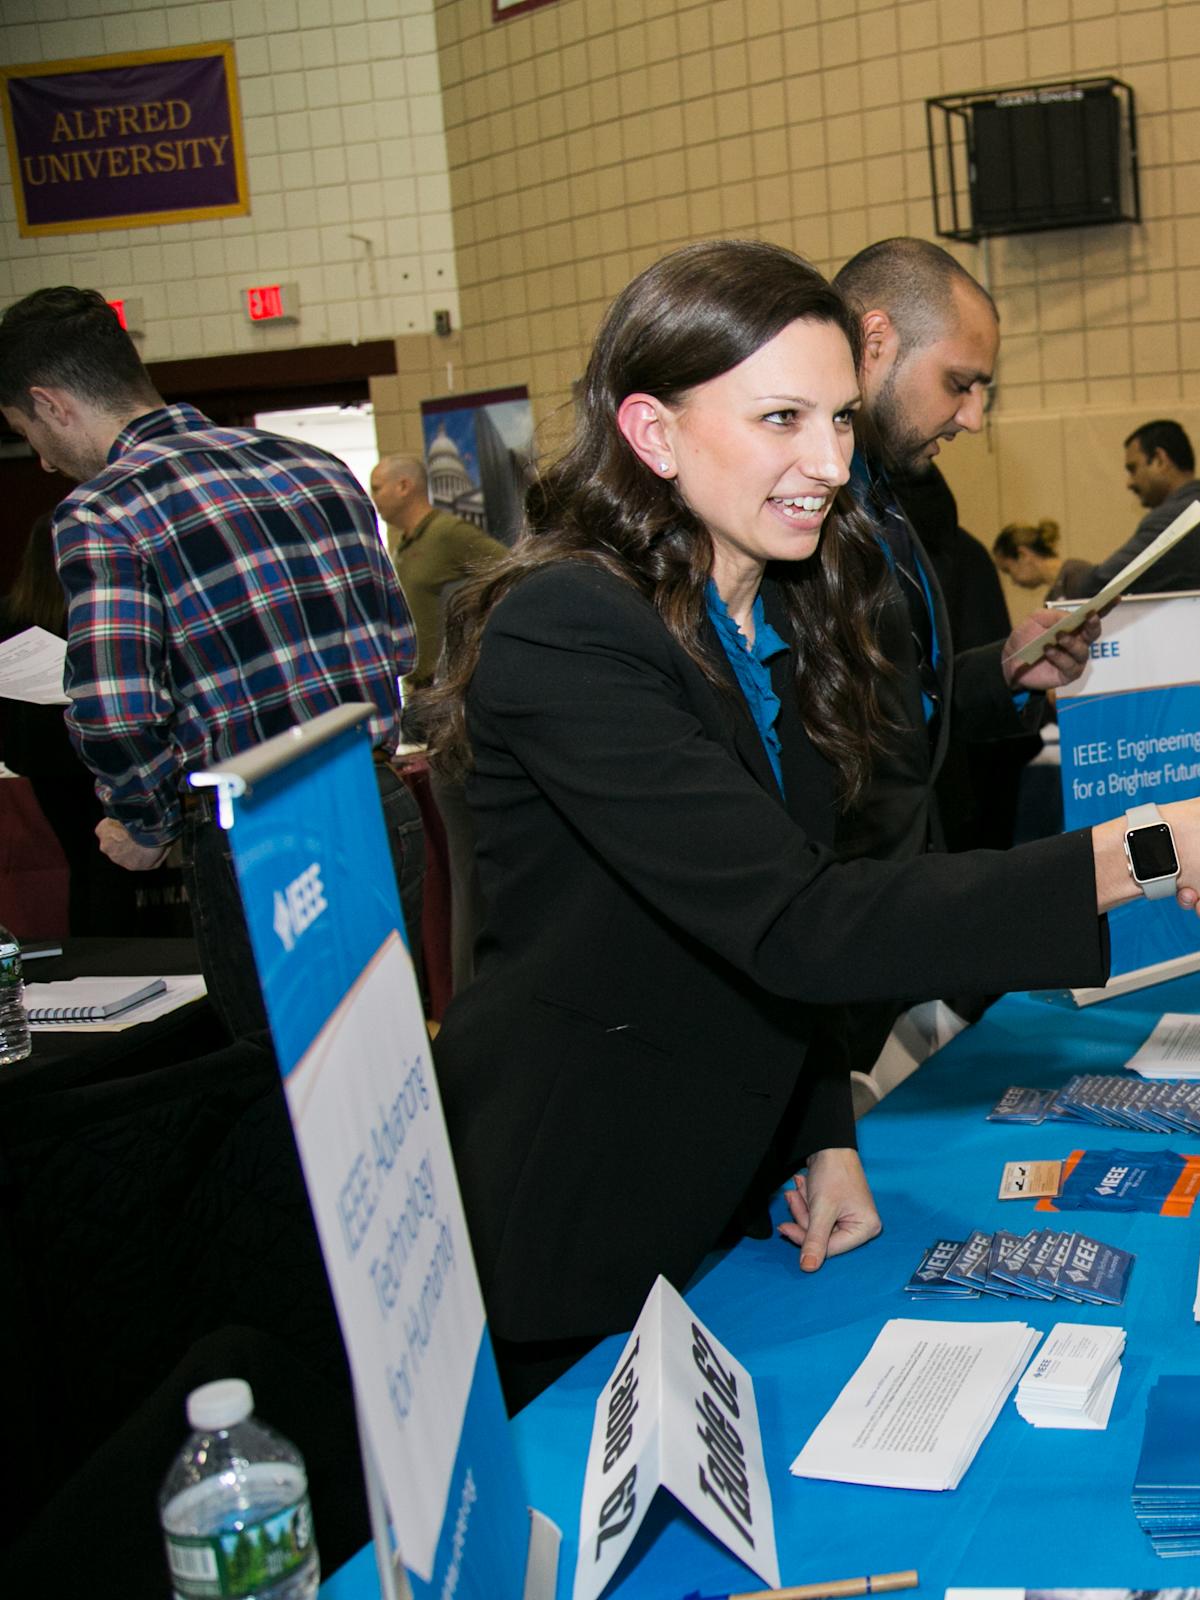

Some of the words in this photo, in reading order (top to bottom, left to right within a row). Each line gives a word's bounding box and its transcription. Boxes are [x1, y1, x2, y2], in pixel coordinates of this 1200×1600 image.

[51, 99, 193, 143] ALFRED
[24, 134, 230, 186] UNIVERSITY
[1073, 741, 1113, 767] IEEE:
[1073, 777, 1097, 801] for
[1096, 779, 1106, 797] a
[1108, 765, 1162, 797] Brighter
[284, 861, 329, 939] IEEE
[1101, 1165, 1130, 1188] IEEE
[925, 1241, 959, 1276] IEEE
[1071, 1239, 1099, 1272] IEEE
[691, 1322, 740, 1420] 62
[602, 1334, 640, 1475] Table
[695, 1390, 755, 1551] Table
[595, 1463, 637, 1564] 62
